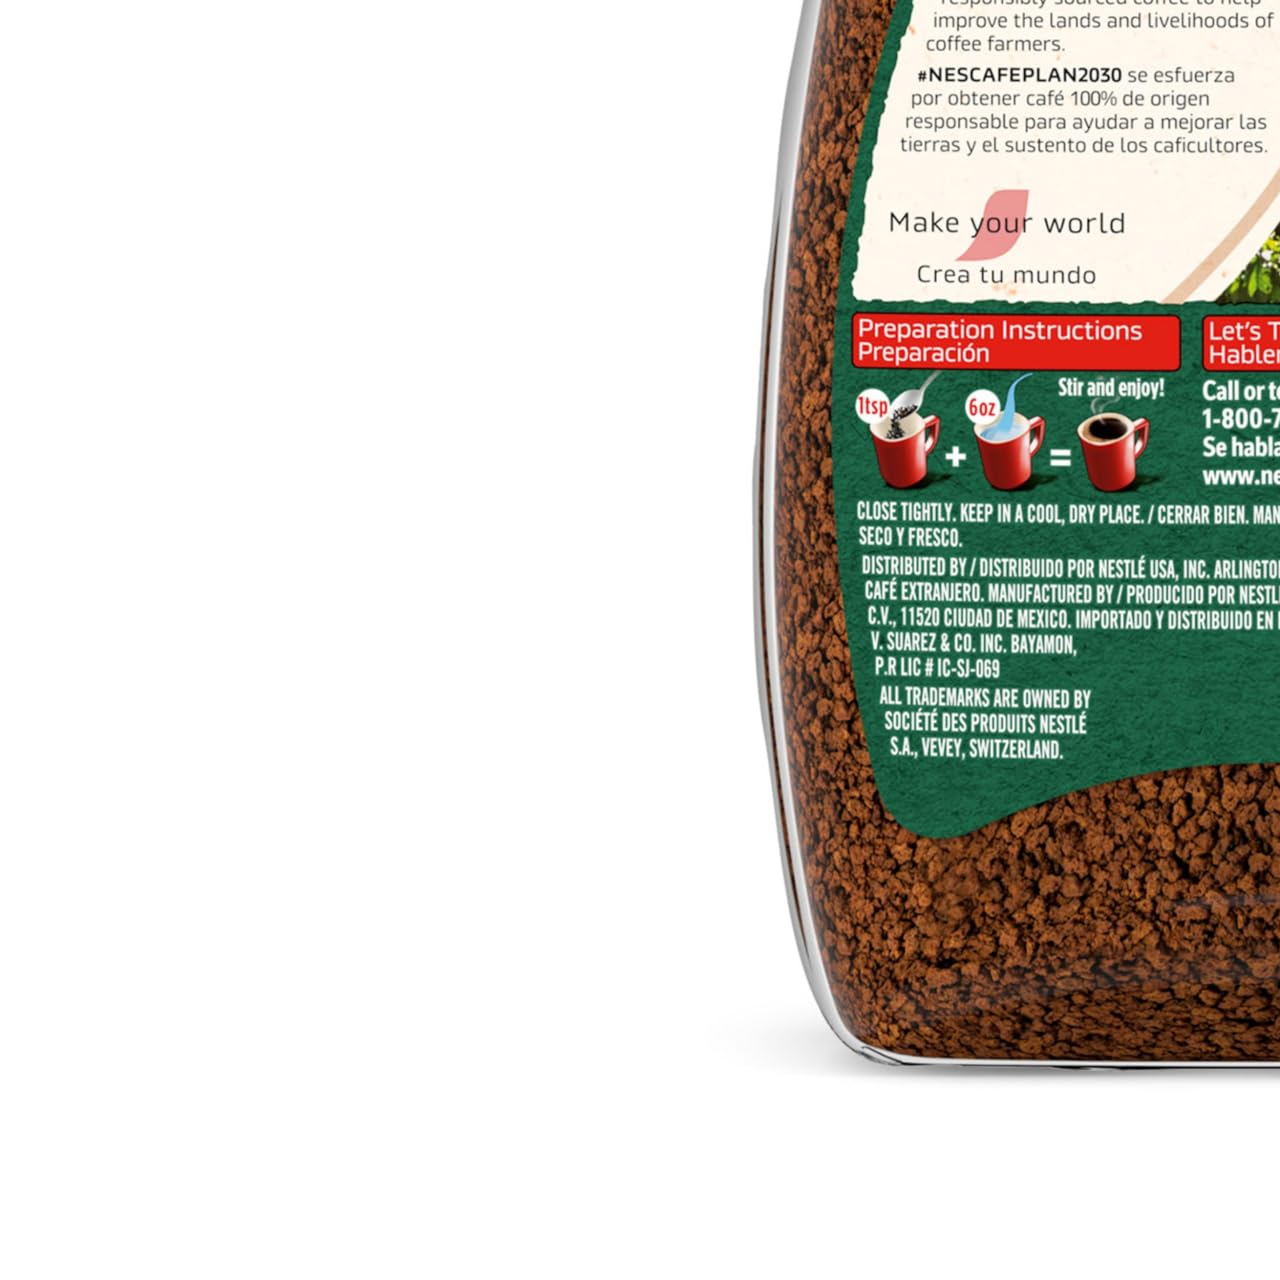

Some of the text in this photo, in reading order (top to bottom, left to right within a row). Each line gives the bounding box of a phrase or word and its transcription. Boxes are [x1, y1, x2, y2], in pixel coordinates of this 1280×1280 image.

[934, 12, 1274, 31] improve the lands and livelihoods of
[926, 35, 1065, 52] coffee farmers.
[918, 66, 1235, 83] #NESCAFEPLAN2030 se esfuerza
[912, 90, 1209, 110] por obtener café 100% de origen
[906, 113, 1267, 134] responsable para ayudar a mejorar las
[901, 136, 1268, 156] tierras y el sustento de los caficultores.
[890, 211, 1124, 238] Make your world
[918, 265, 1096, 284] Crea tu mundo
[859, 319, 1142, 342] Preparation Instructions
[859, 342, 989, 366] Preparación
[1058, 377, 1164, 400] Stir and enjoy!
[1203, 380, 1239, 401] Call
[1244, 385, 1265, 401] or
[858, 396, 888, 416] 1tsp
[969, 399, 995, 416] 6oz
[1203, 436, 1227, 457] Se
[857, 501, 897, 521] CLOSE
[901, 502, 956, 522] TIGHTLY.
[960, 503, 993, 522] KEEP
[998, 504, 1011, 522] IN
[1015, 504, 1023, 522] A
[1027, 504, 1065, 525] COOL,
[1069, 504, 1095, 523] DRY
[1099, 504, 1144, 524] PLACE.
[1148, 505, 1154, 524] /
[1158, 505, 1210, 524] CERRAR
[1214, 505, 1249, 524] BIEN.
[859, 526, 962, 547] SECO Y FRESCO.
[862, 555, 945, 576] DISTRIBUTED
[950, 557, 967, 576] BY
[970, 558, 976, 576] /
[980, 558, 1063, 578] DISTRIBUIDO
[1068, 559, 1094, 578] POR
[1099, 555, 1146, 578] NESTLÉ
[1150, 559, 1179, 581] USA,
[1184, 560, 1210, 579] INC.
[871, 631, 1077, 656] V. SUAREZ & CO. INC. BAYAMON,
[880, 686, 1091, 709] ALL TRADEMARKS ARE OWNED BY
[885, 708, 1087, 734] SOCIÉTÉ DES PRODUITS NESTLÉ
